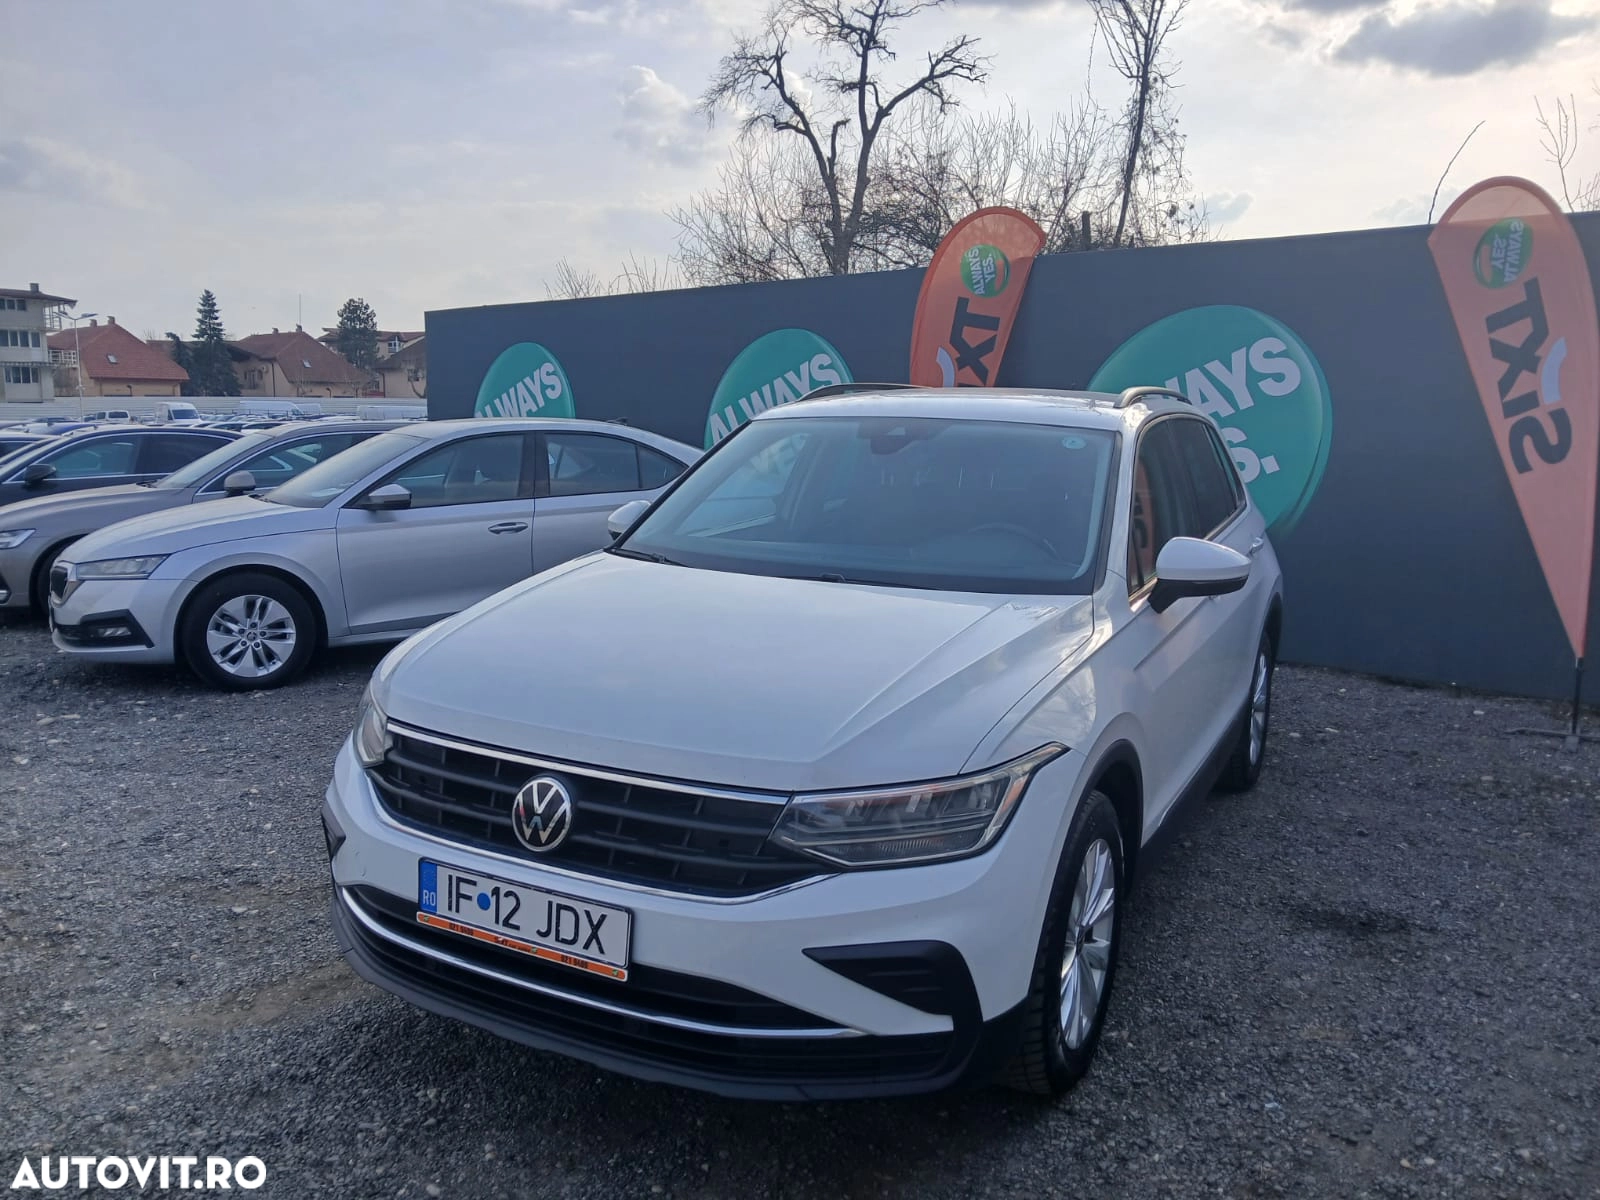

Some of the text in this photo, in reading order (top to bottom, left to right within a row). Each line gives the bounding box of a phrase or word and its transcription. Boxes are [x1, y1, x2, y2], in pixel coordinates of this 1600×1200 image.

[968, 248, 985, 295] ALWAYS
[423, 889, 436, 907] RO
[447, 874, 607, 955] IF 12 JDX
